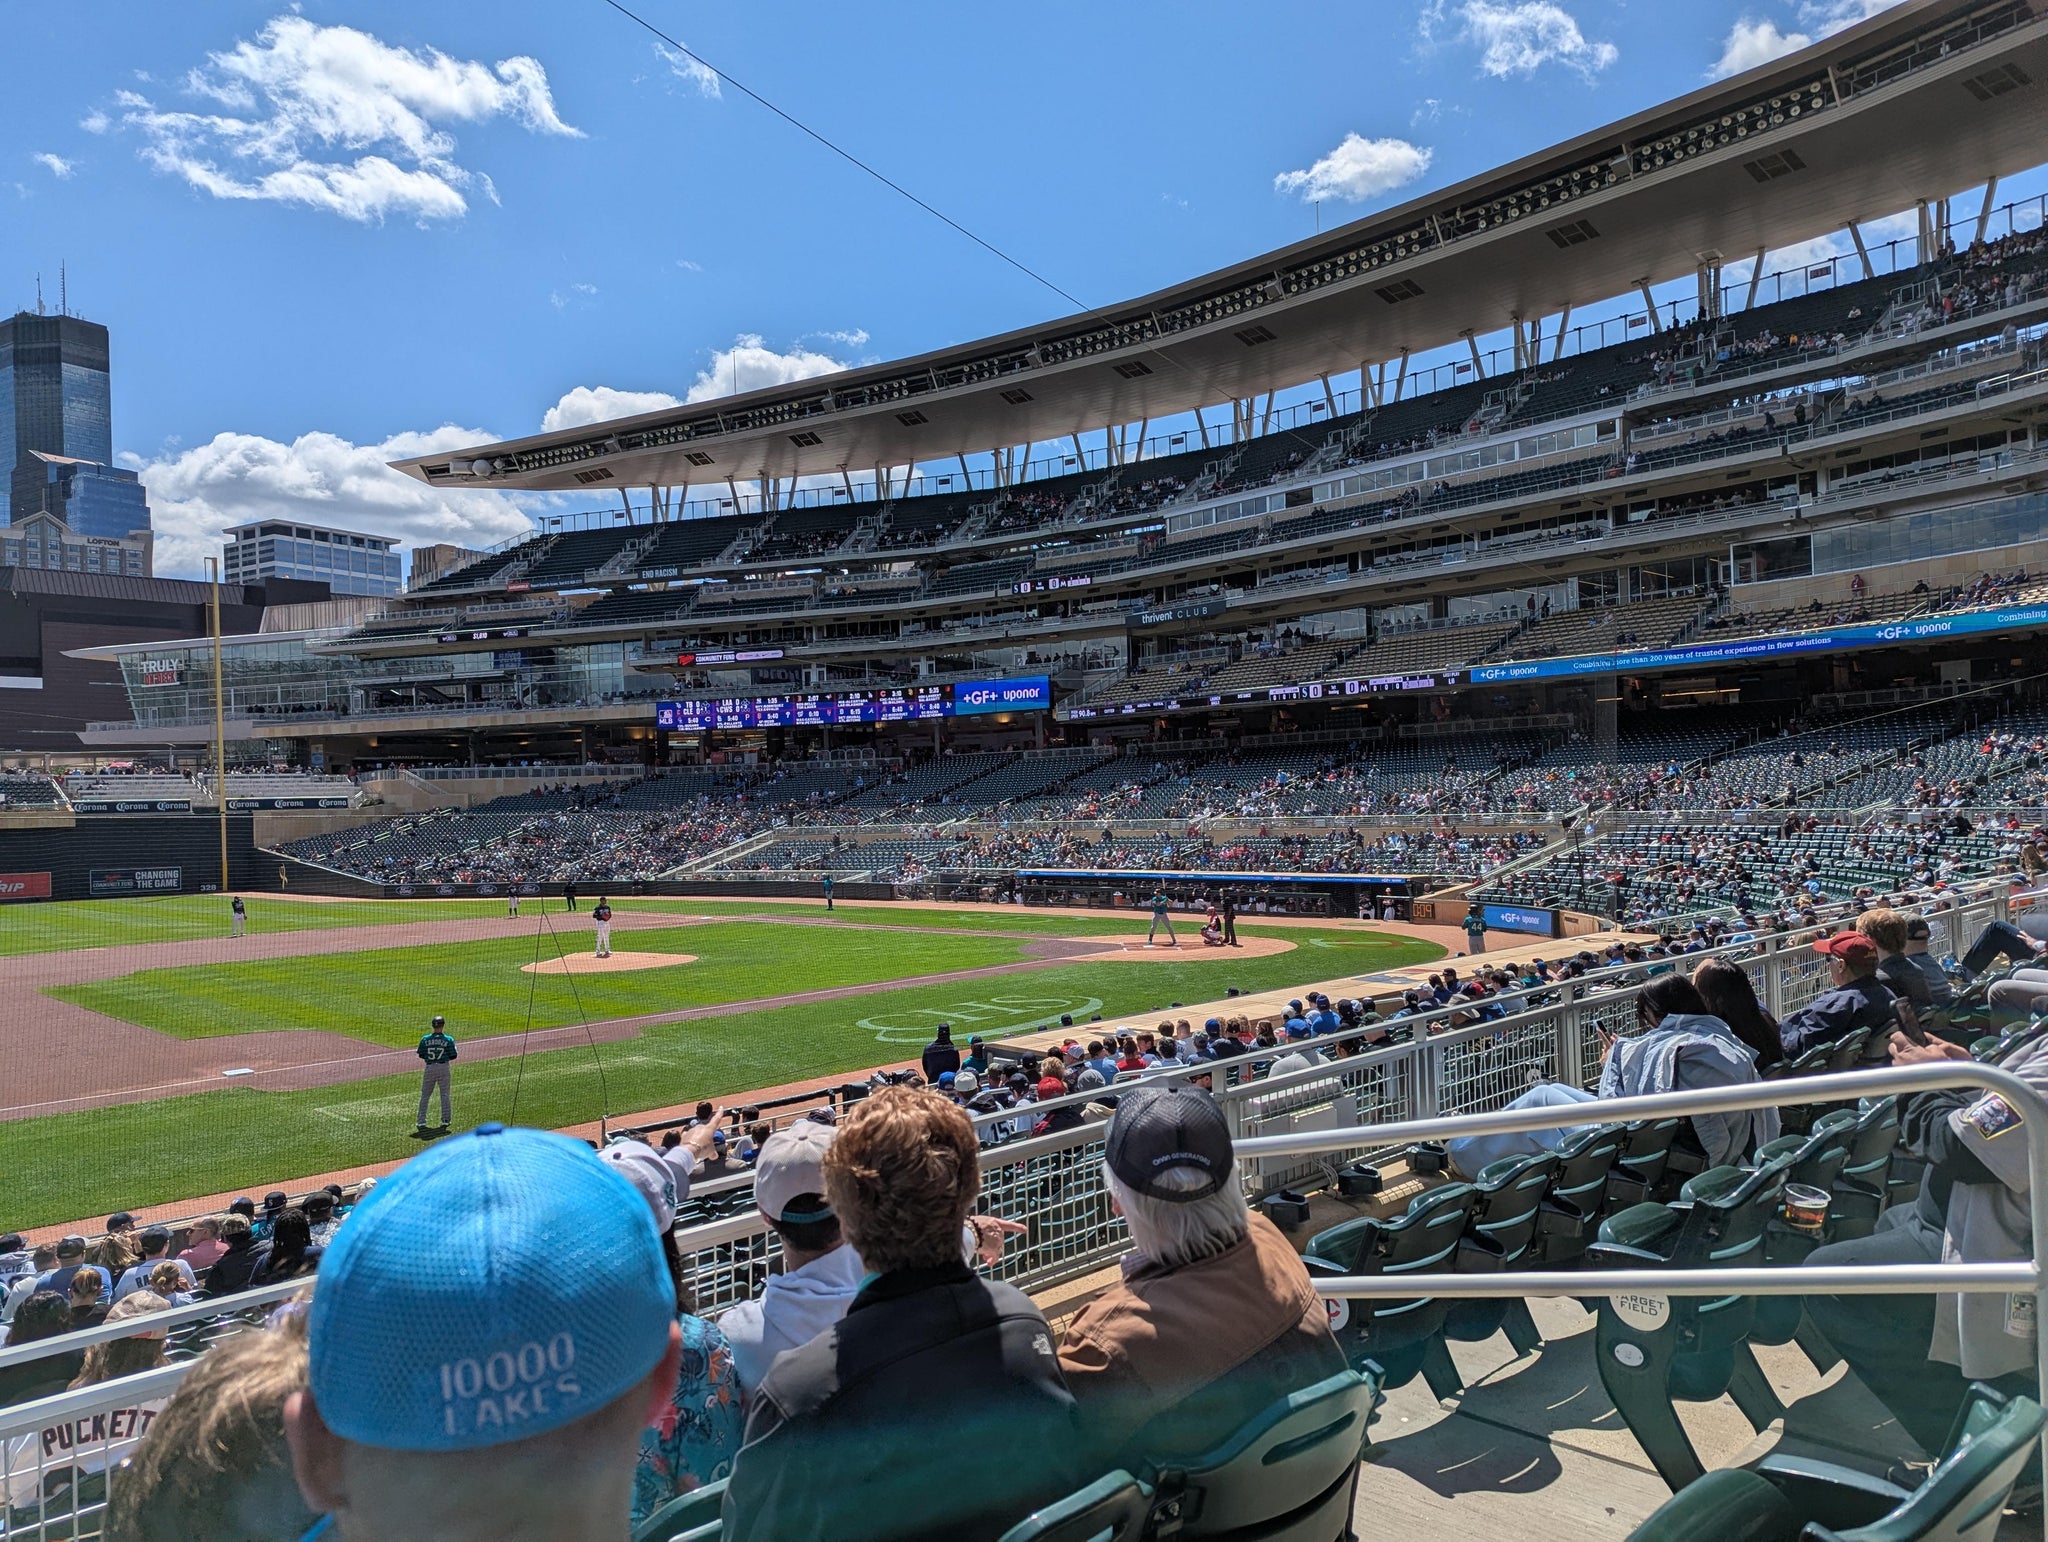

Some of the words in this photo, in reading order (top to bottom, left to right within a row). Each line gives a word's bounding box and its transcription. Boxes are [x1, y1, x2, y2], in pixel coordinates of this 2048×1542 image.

[87, 538, 120, 546] LOFTON
[642, 570, 654, 578] END
[655, 568, 678, 577] RACISM
[1142, 611, 1172, 623] thrivent
[1177, 607, 1208, 618] CLUB
[1998, 610, 2047, 622] Combining
[1916, 622, 1952, 635] uponor
[1632, 655, 1648, 664] than
[1664, 653, 1684, 662] years
[1695, 648, 1723, 658] trusted
[1724, 644, 1766, 655] experience
[1777, 640, 1794, 649] flow
[1796, 636, 1831, 646] solutions
[141, 659, 178, 673] TRULY
[1510, 666, 1538, 676] uponor
[1004, 688, 1040, 702] uponor
[1302, 687, 1307, 698] S
[74, 803, 107, 812] Corona
[116, 802, 148, 811] Corona
[157, 801, 189, 810] Corona
[229, 800, 259, 809] Corona
[274, 799, 304, 808] Corona
[318, 798, 347, 808] Corona
[135, 870, 178, 880] CHANGING
[137, 880, 153, 889] THE
[154, 879, 178, 888] GAME
[1413, 904, 1432, 917] 0:09
[1522, 915, 1540, 924] uponor
[1471, 922, 1482, 931] 44
[427, 1047, 444, 1060] 57
[1171, 1152, 1210, 1166] GENERATORS
[1616, 1295, 1664, 1309] ARGET
[1620, 1301, 1658, 1316] FIELD
[440, 1332, 574, 1401] 10000
[445, 1372, 581, 1435] LAKES
[42, 1408, 157, 1457] PUCKETT
